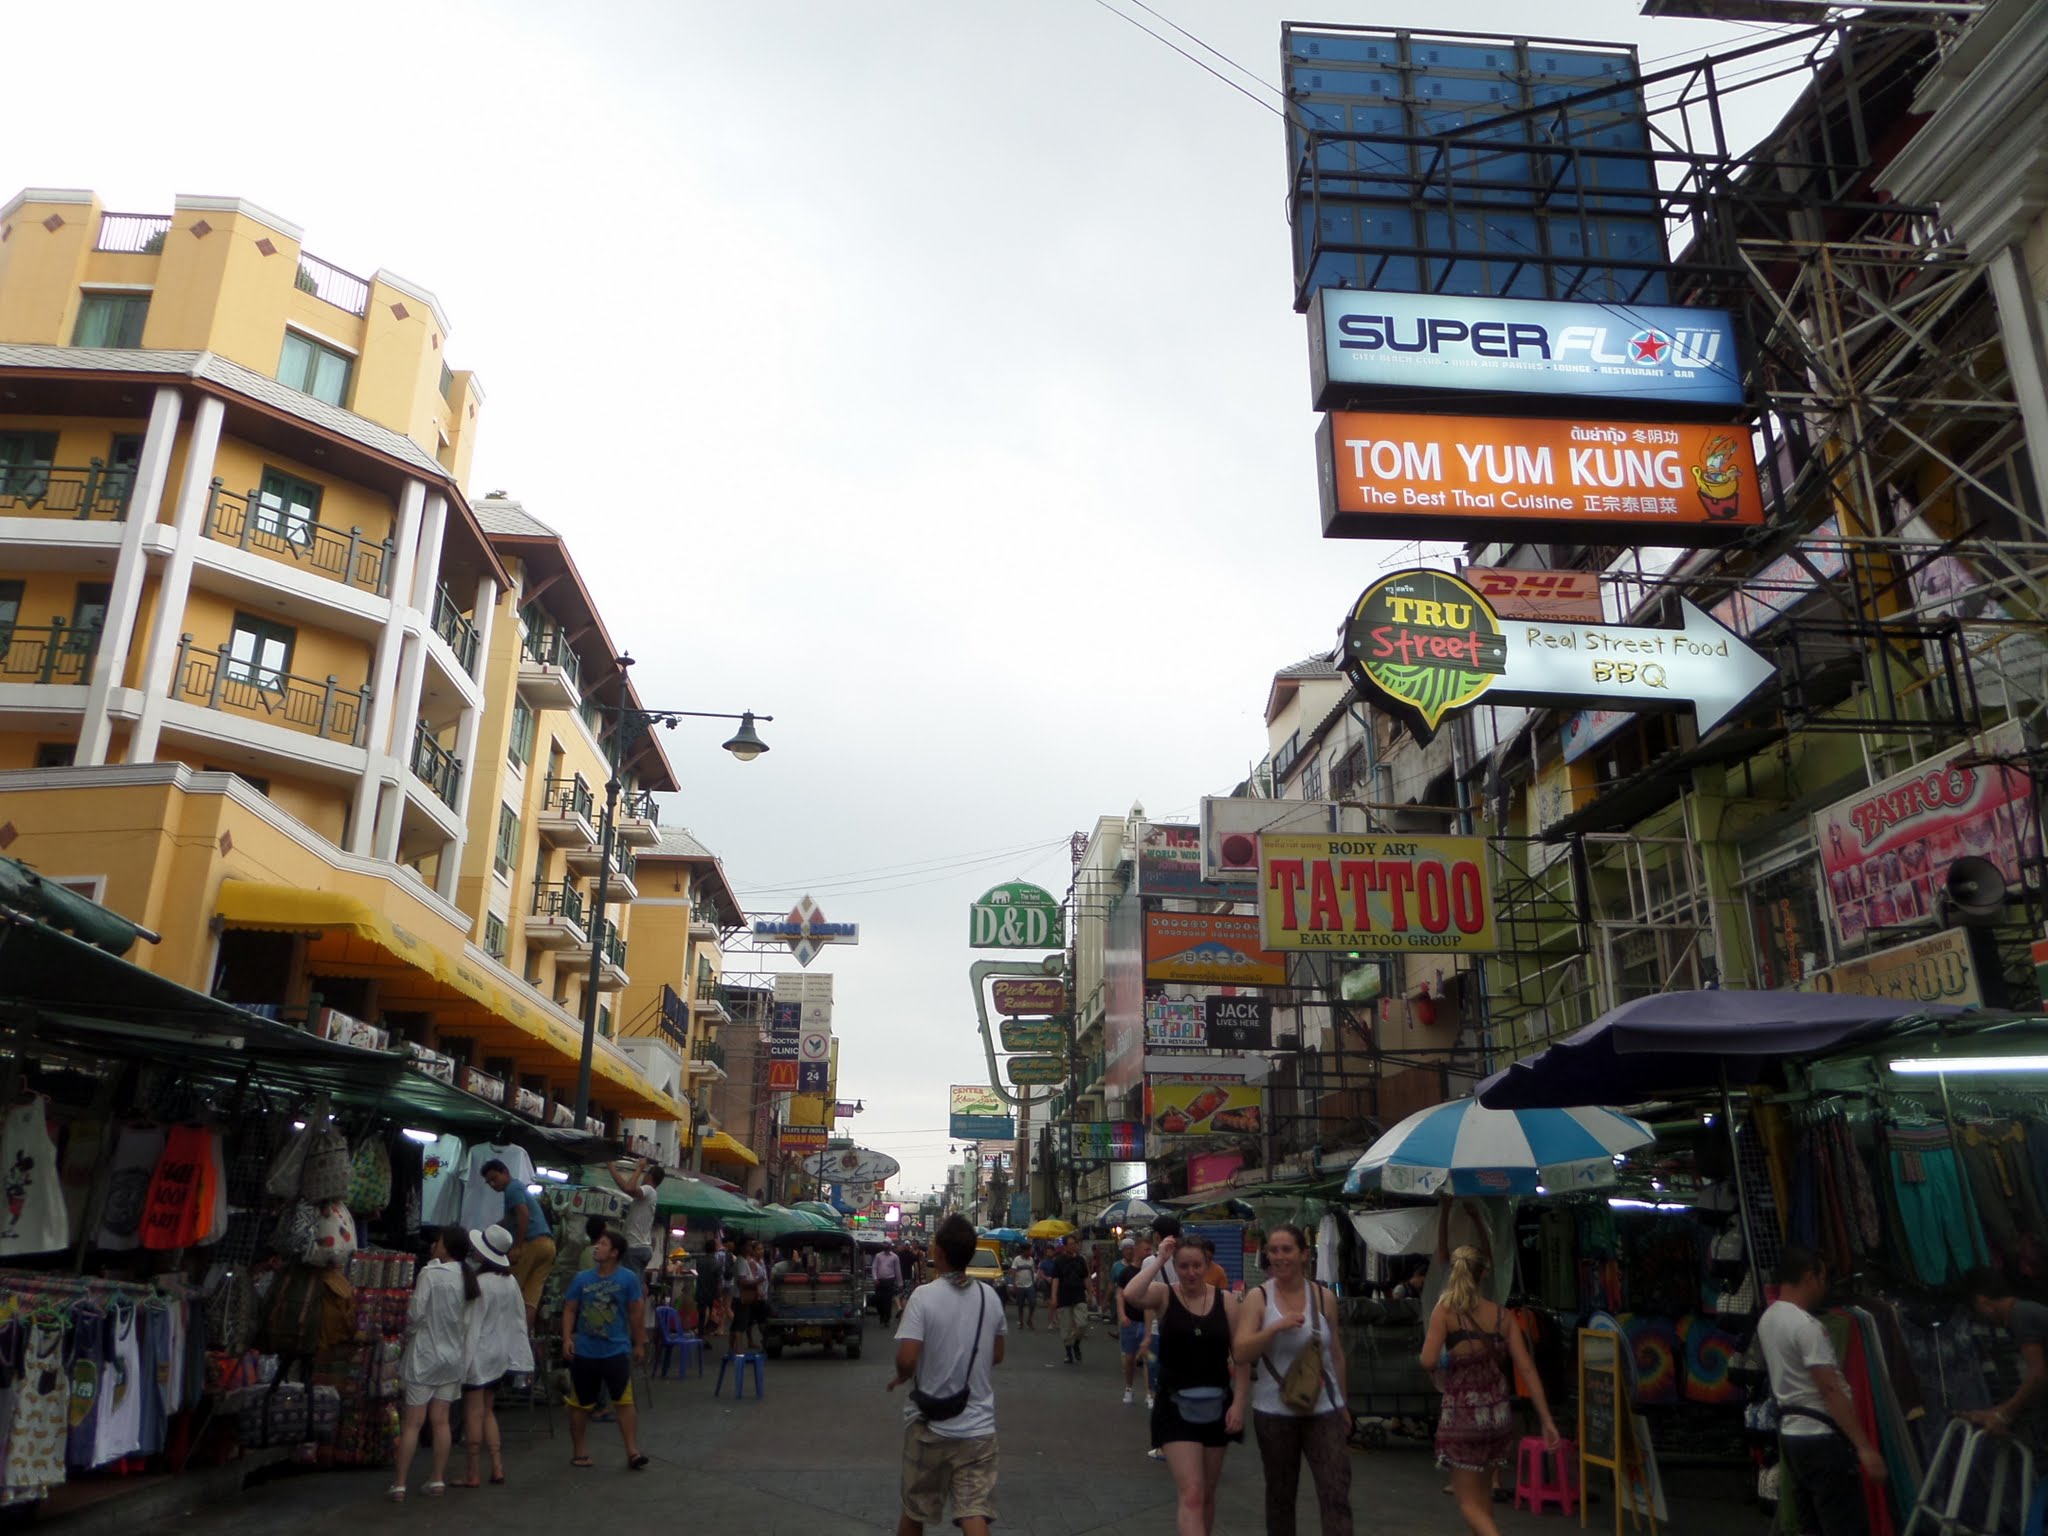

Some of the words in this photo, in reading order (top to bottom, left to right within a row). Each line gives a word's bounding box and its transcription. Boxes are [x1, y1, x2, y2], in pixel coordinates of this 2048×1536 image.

[1502, 360, 1544, 371] PARTIES
[1553, 362, 1592, 373] LOUNGE
[1601, 366, 1665, 378] RESTAURANT
[1674, 369, 1696, 379] BAR
[1632, 429, 1679, 444] 冬阴功
[1344, 439, 1442, 482] TOM
[1455, 444, 1554, 486] YUM
[1568, 448, 1685, 489] KUNG
[1359, 486, 1398, 504] The
[1402, 488, 1447, 507] Best
[1451, 490, 1495, 509] Thai
[1500, 491, 1574, 511] Cuisine
[1583, 495, 1679, 513] 正宗泰国菜
[1480, 575, 1585, 598] DHL
[1385, 596, 1472, 630] TRU
[1371, 626, 1484, 667] Street
[1526, 628, 1577, 651] Real
[1586, 631, 1665, 655] Street
[1674, 636, 1729, 657] Food
[1593, 659, 1669, 690] BBQ
[1849, 762, 1978, 848] TATTOO
[1328, 842, 1377, 856] BODY
[1381, 843, 1418, 856] ART
[1268, 858, 1486, 936] TATTOO
[973, 906, 1048, 947] D&D
[1299, 933, 1333, 946] EAK
[1338, 934, 1403, 947] TATTOO
[1407, 935, 1463, 947] GROUP
[1215, 1003, 1260, 1019] JACK
[1239, 1019, 1260, 1028] HERE
[771, 1047, 800, 1055] CLINIC
[806, 1071, 820, 1081] 24
